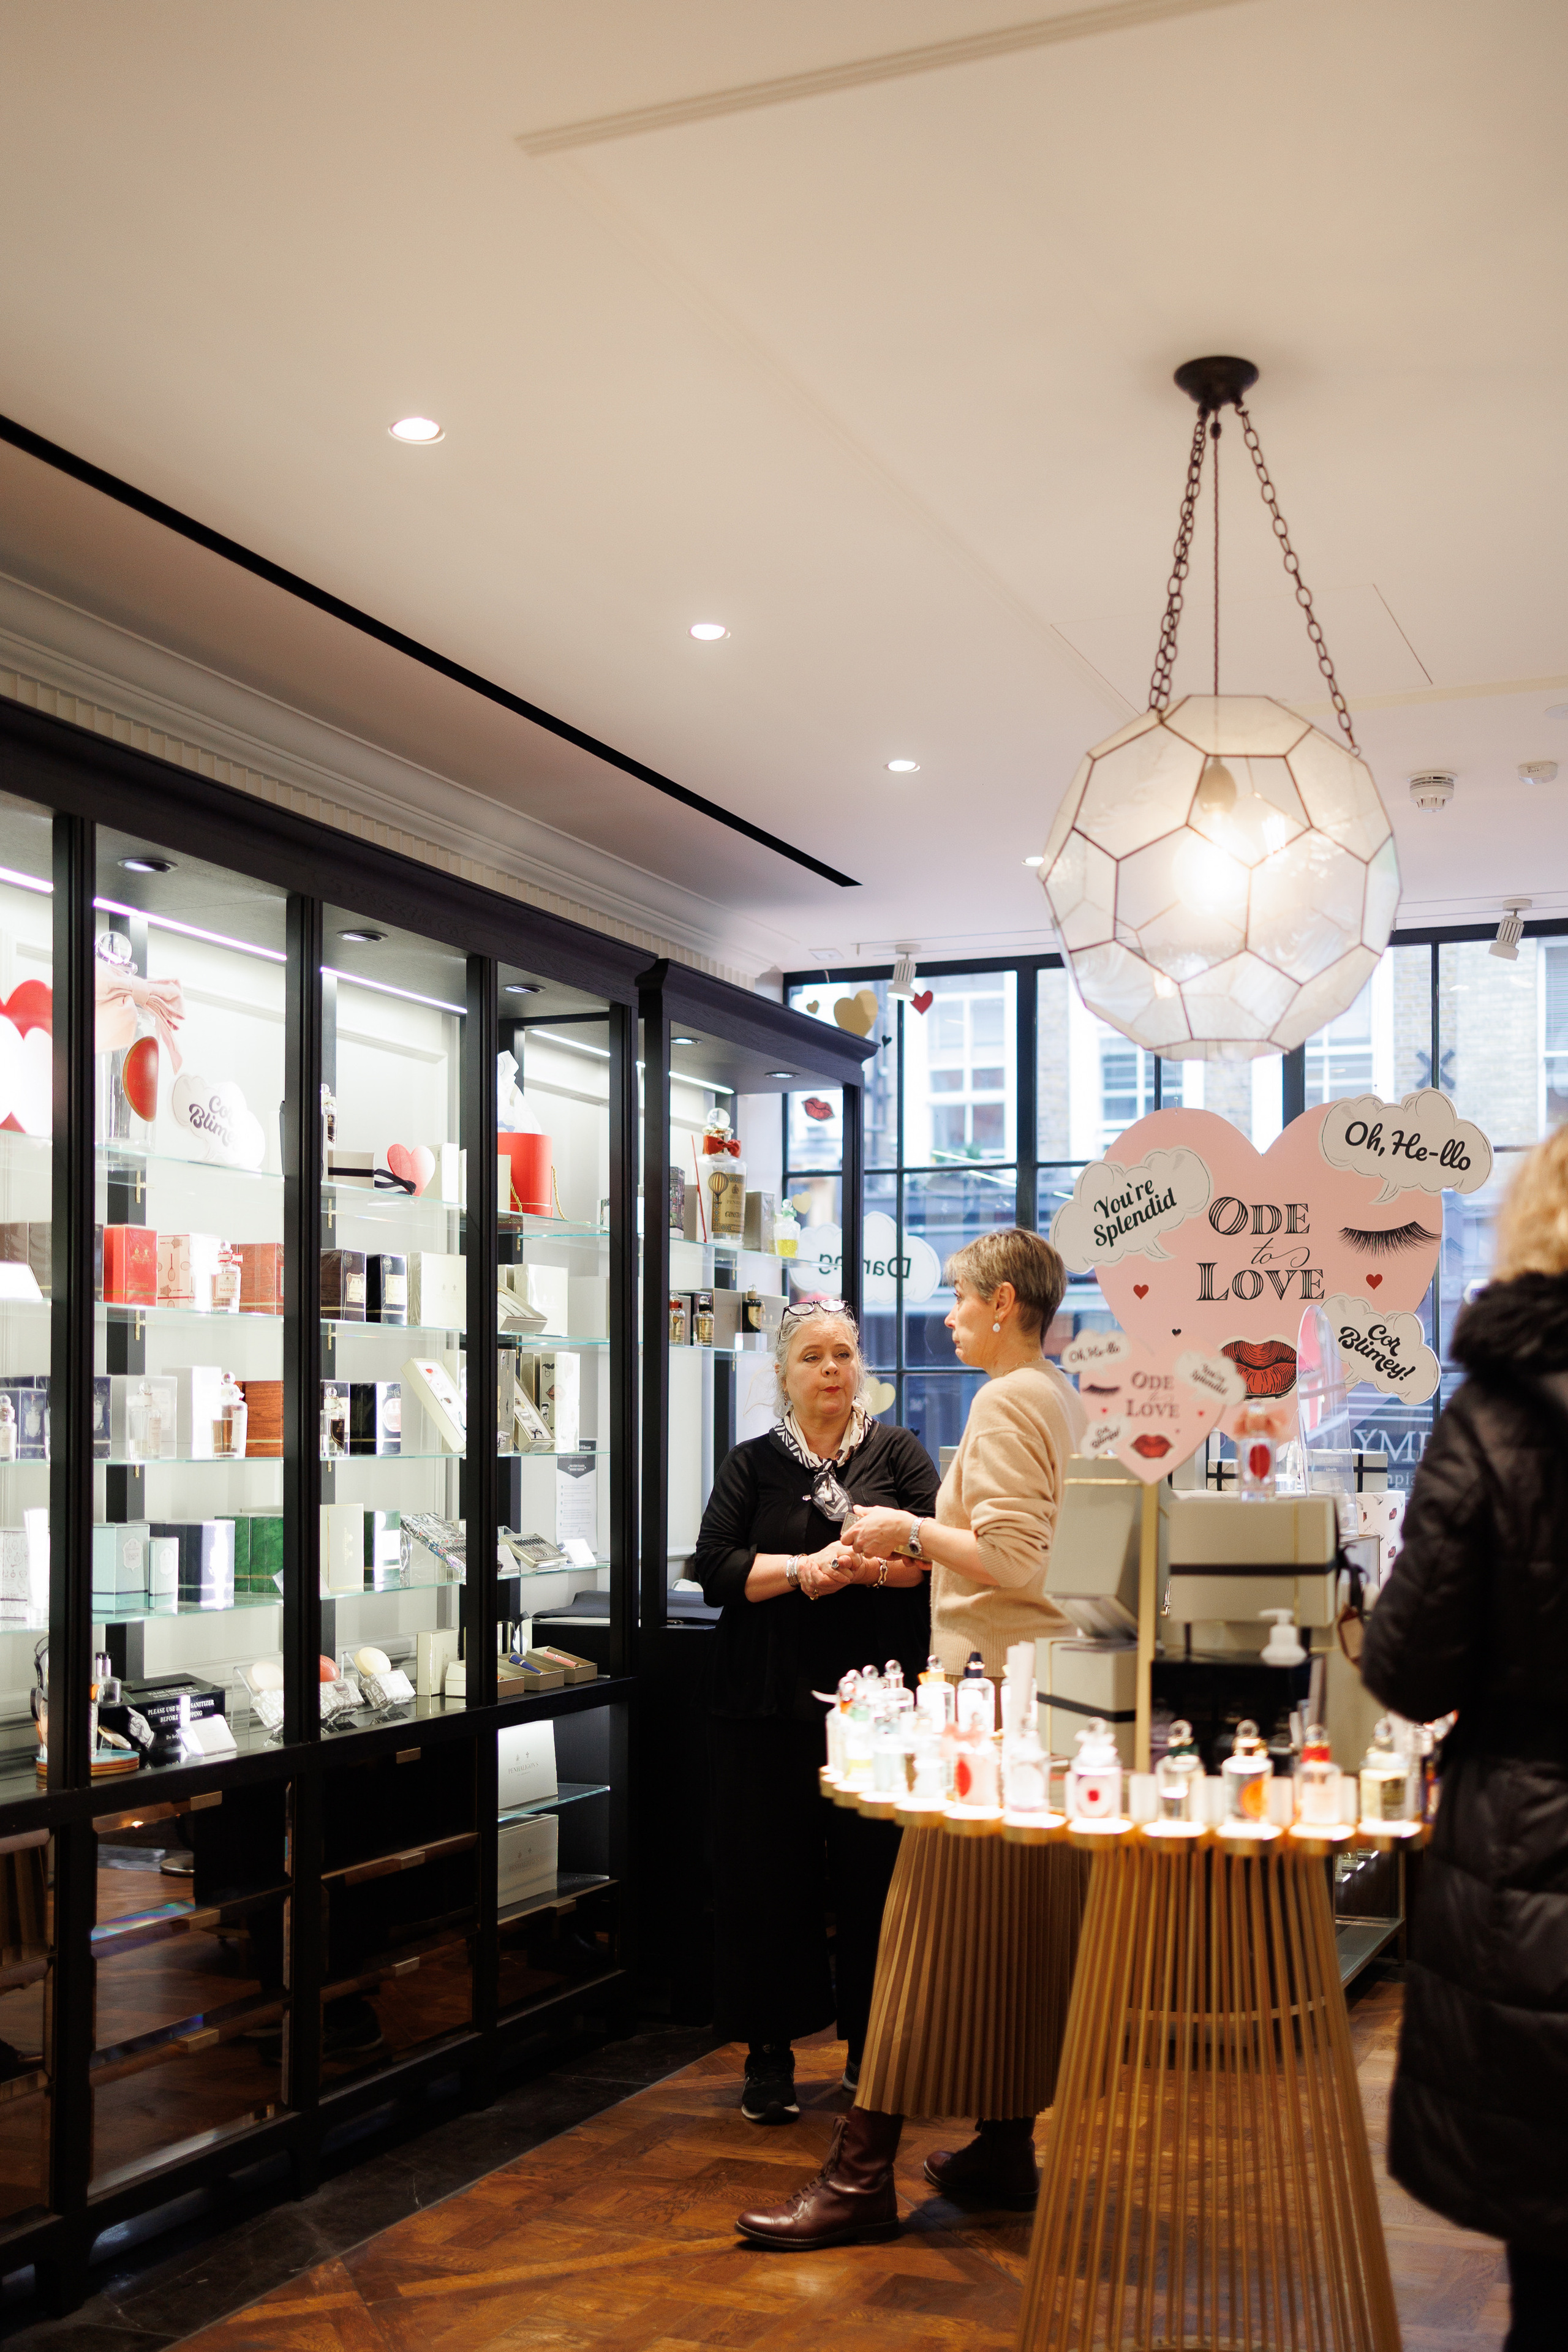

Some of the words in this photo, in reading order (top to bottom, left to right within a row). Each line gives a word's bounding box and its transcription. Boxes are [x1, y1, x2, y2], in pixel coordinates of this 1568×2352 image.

[1345, 1121, 1385, 1156] Oh,
[1392, 1130, 1471, 1170] He-llo
[1094, 1187, 1177, 1248] Splendid
[1208, 1196, 1310, 1235] ODE
[1251, 1237, 1310, 1268] to
[1196, 1262, 1325, 1301] LOVE
[1338, 1326, 1415, 1381] Blimey!
[1368, 1324, 1400, 1357] Cor
[1131, 1371, 1174, 1390] ODE
[1126, 1399, 1180, 1418] LOVE
[148, 1707, 165, 1716] PLEASE
[190, 1699, 214, 1708] SANITIZER
[160, 1714, 179, 1723] BEFORE
